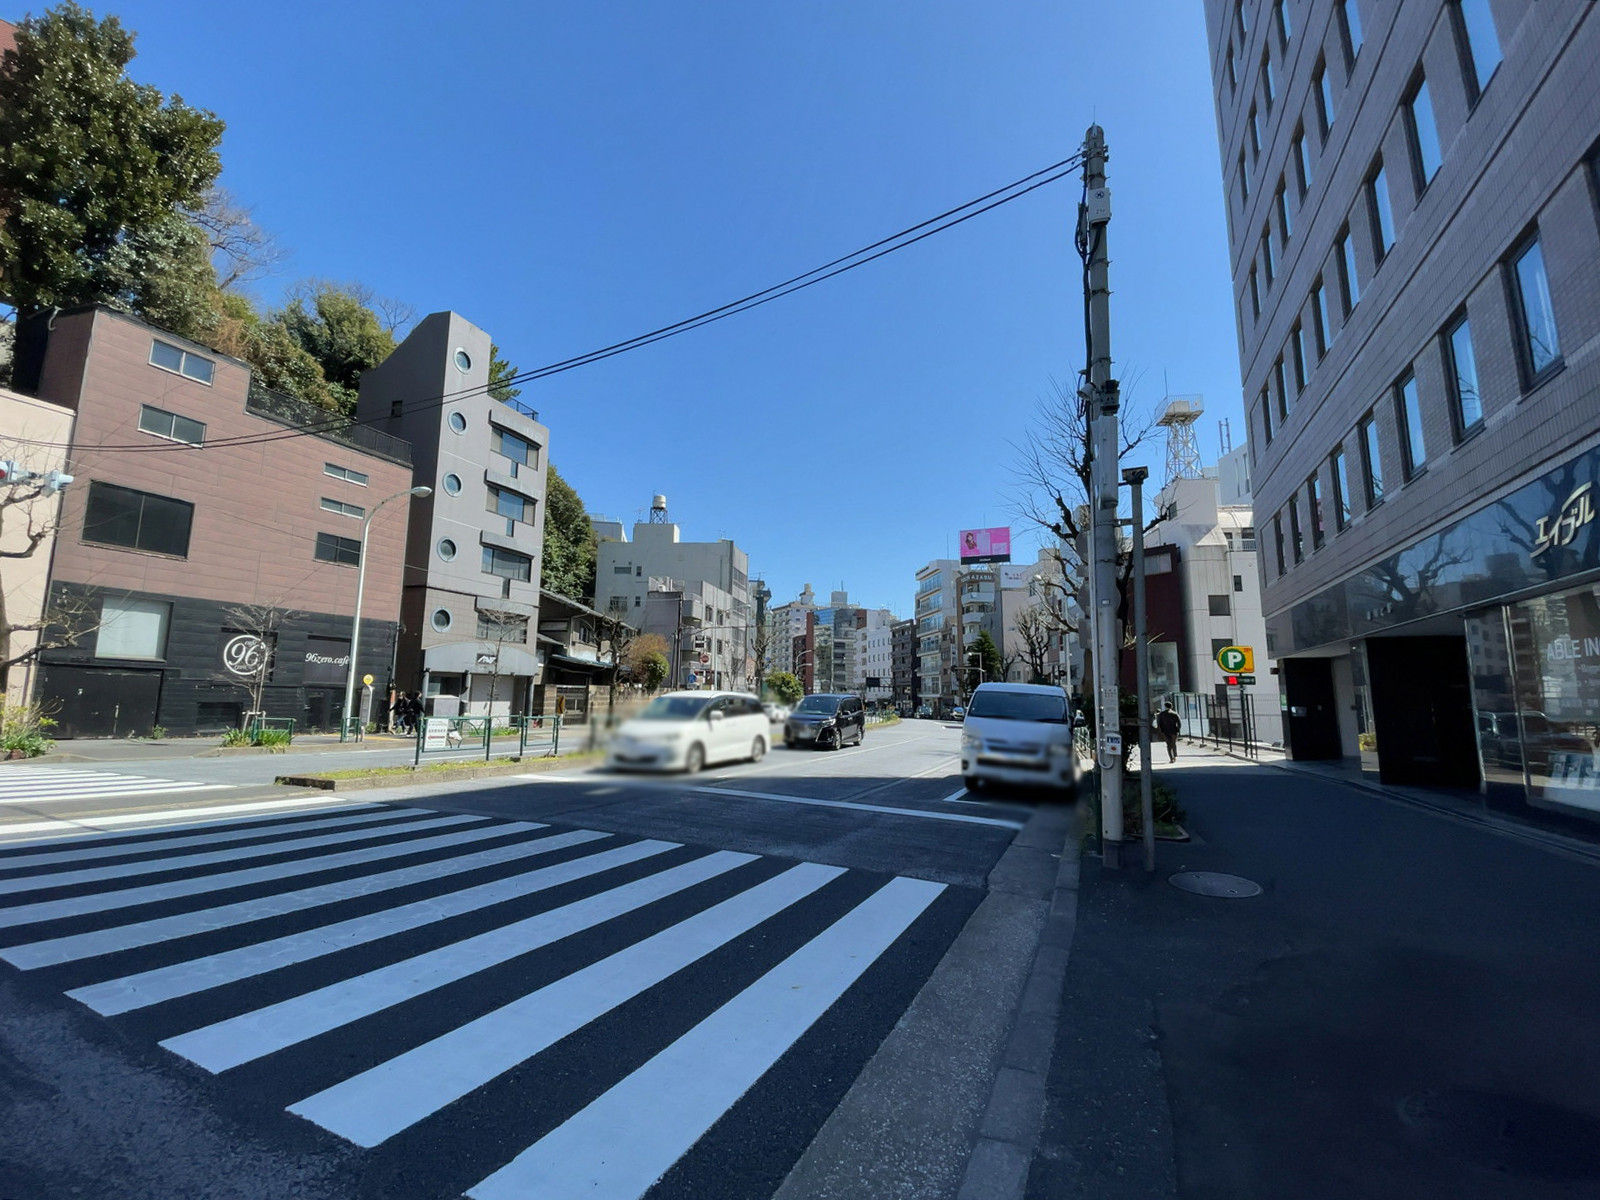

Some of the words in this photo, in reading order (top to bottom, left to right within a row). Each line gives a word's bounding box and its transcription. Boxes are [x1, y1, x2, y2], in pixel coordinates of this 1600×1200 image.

[1530, 481, 1595, 558] エイブル
[228, 643, 261, 666] 96
[1227, 651, 1242, 668] P
[1546, 639, 1582, 662] ABLE
[1583, 636, 1600, 657] IN
